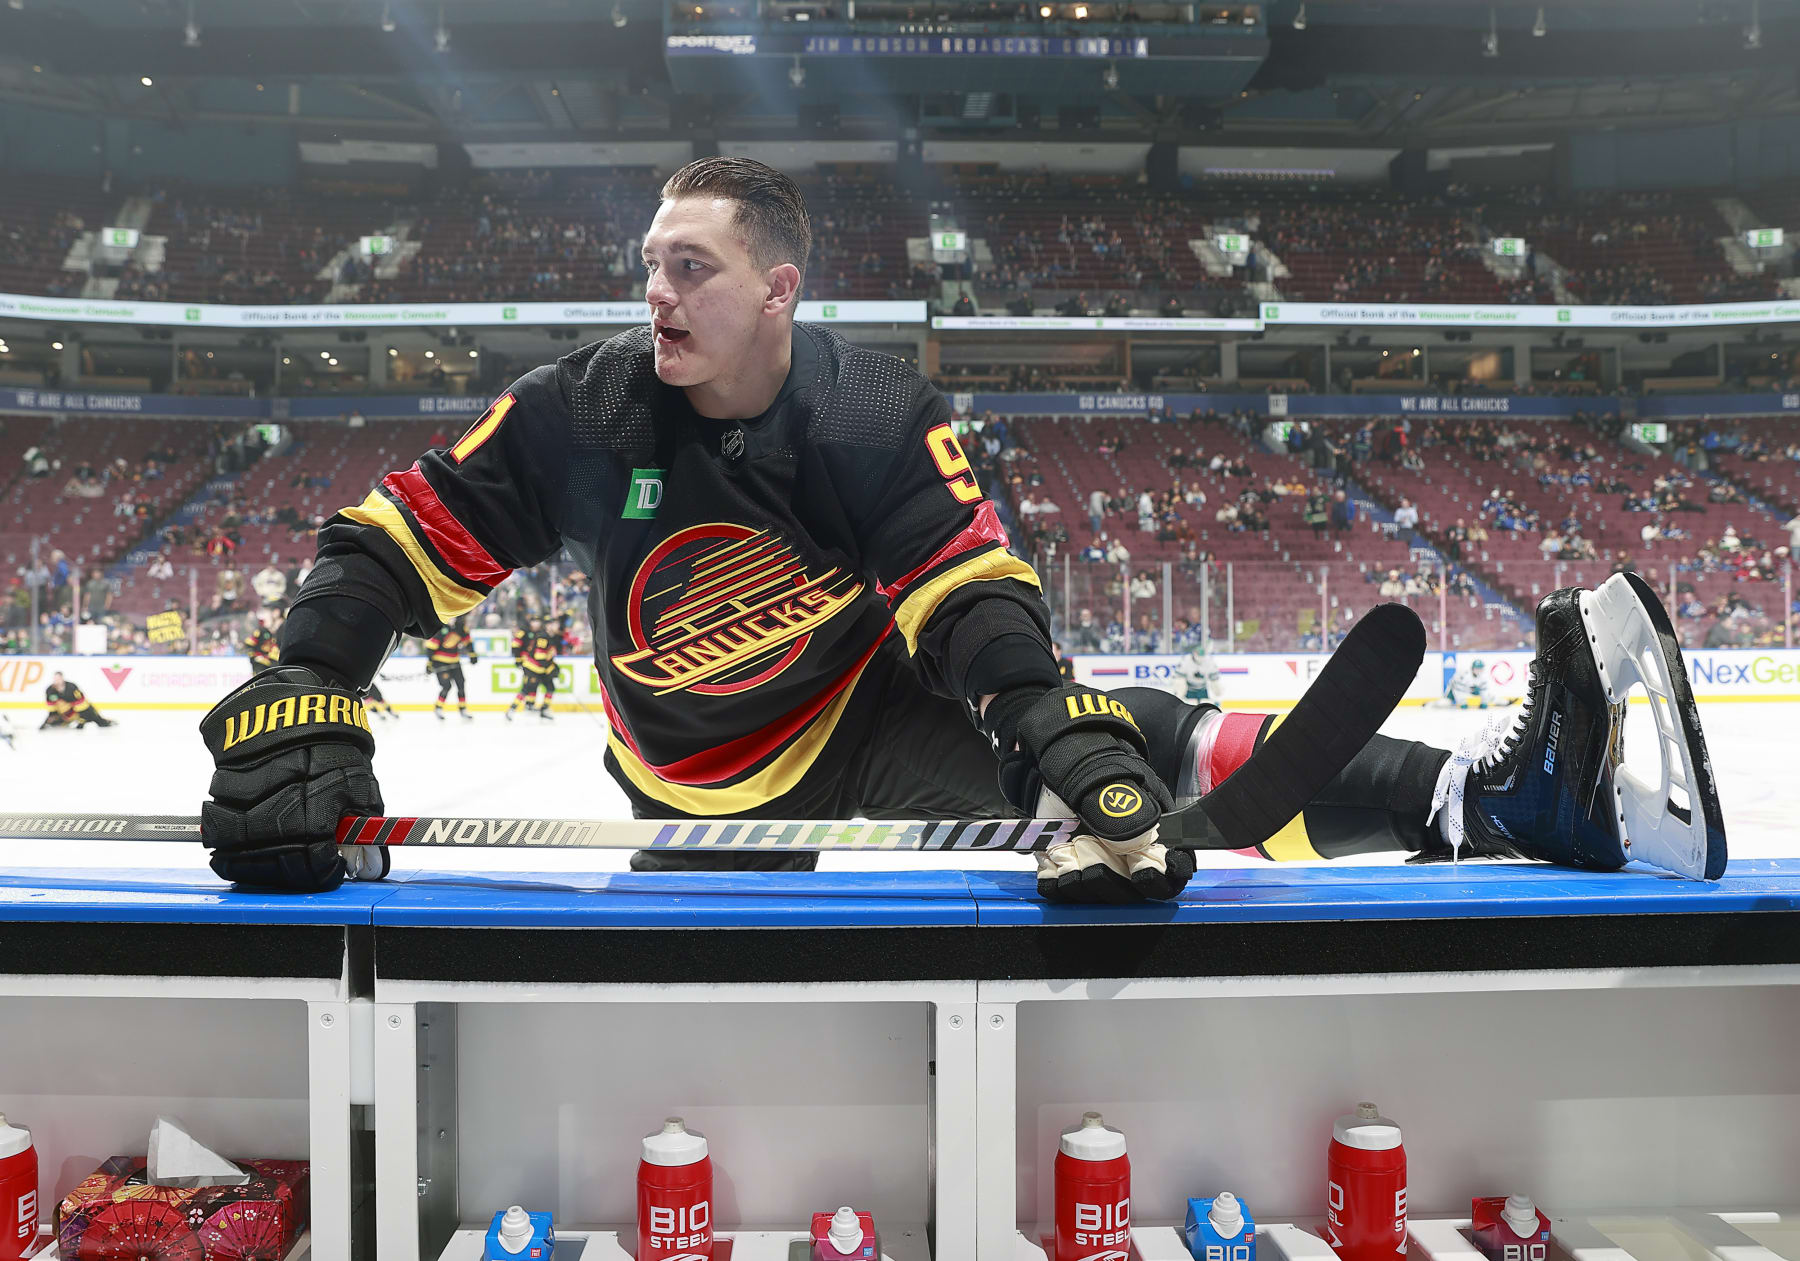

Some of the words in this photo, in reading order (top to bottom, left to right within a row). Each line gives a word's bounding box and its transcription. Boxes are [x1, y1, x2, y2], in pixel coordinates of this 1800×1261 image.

[635, 478, 663, 509] TD
[1543, 711, 1562, 776] BAUER
[650, 1201, 709, 1234] BIO
[1075, 1198, 1130, 1231] BIO
[650, 1233, 709, 1249] STEEL
[1075, 1231, 1131, 1247] STEEL
